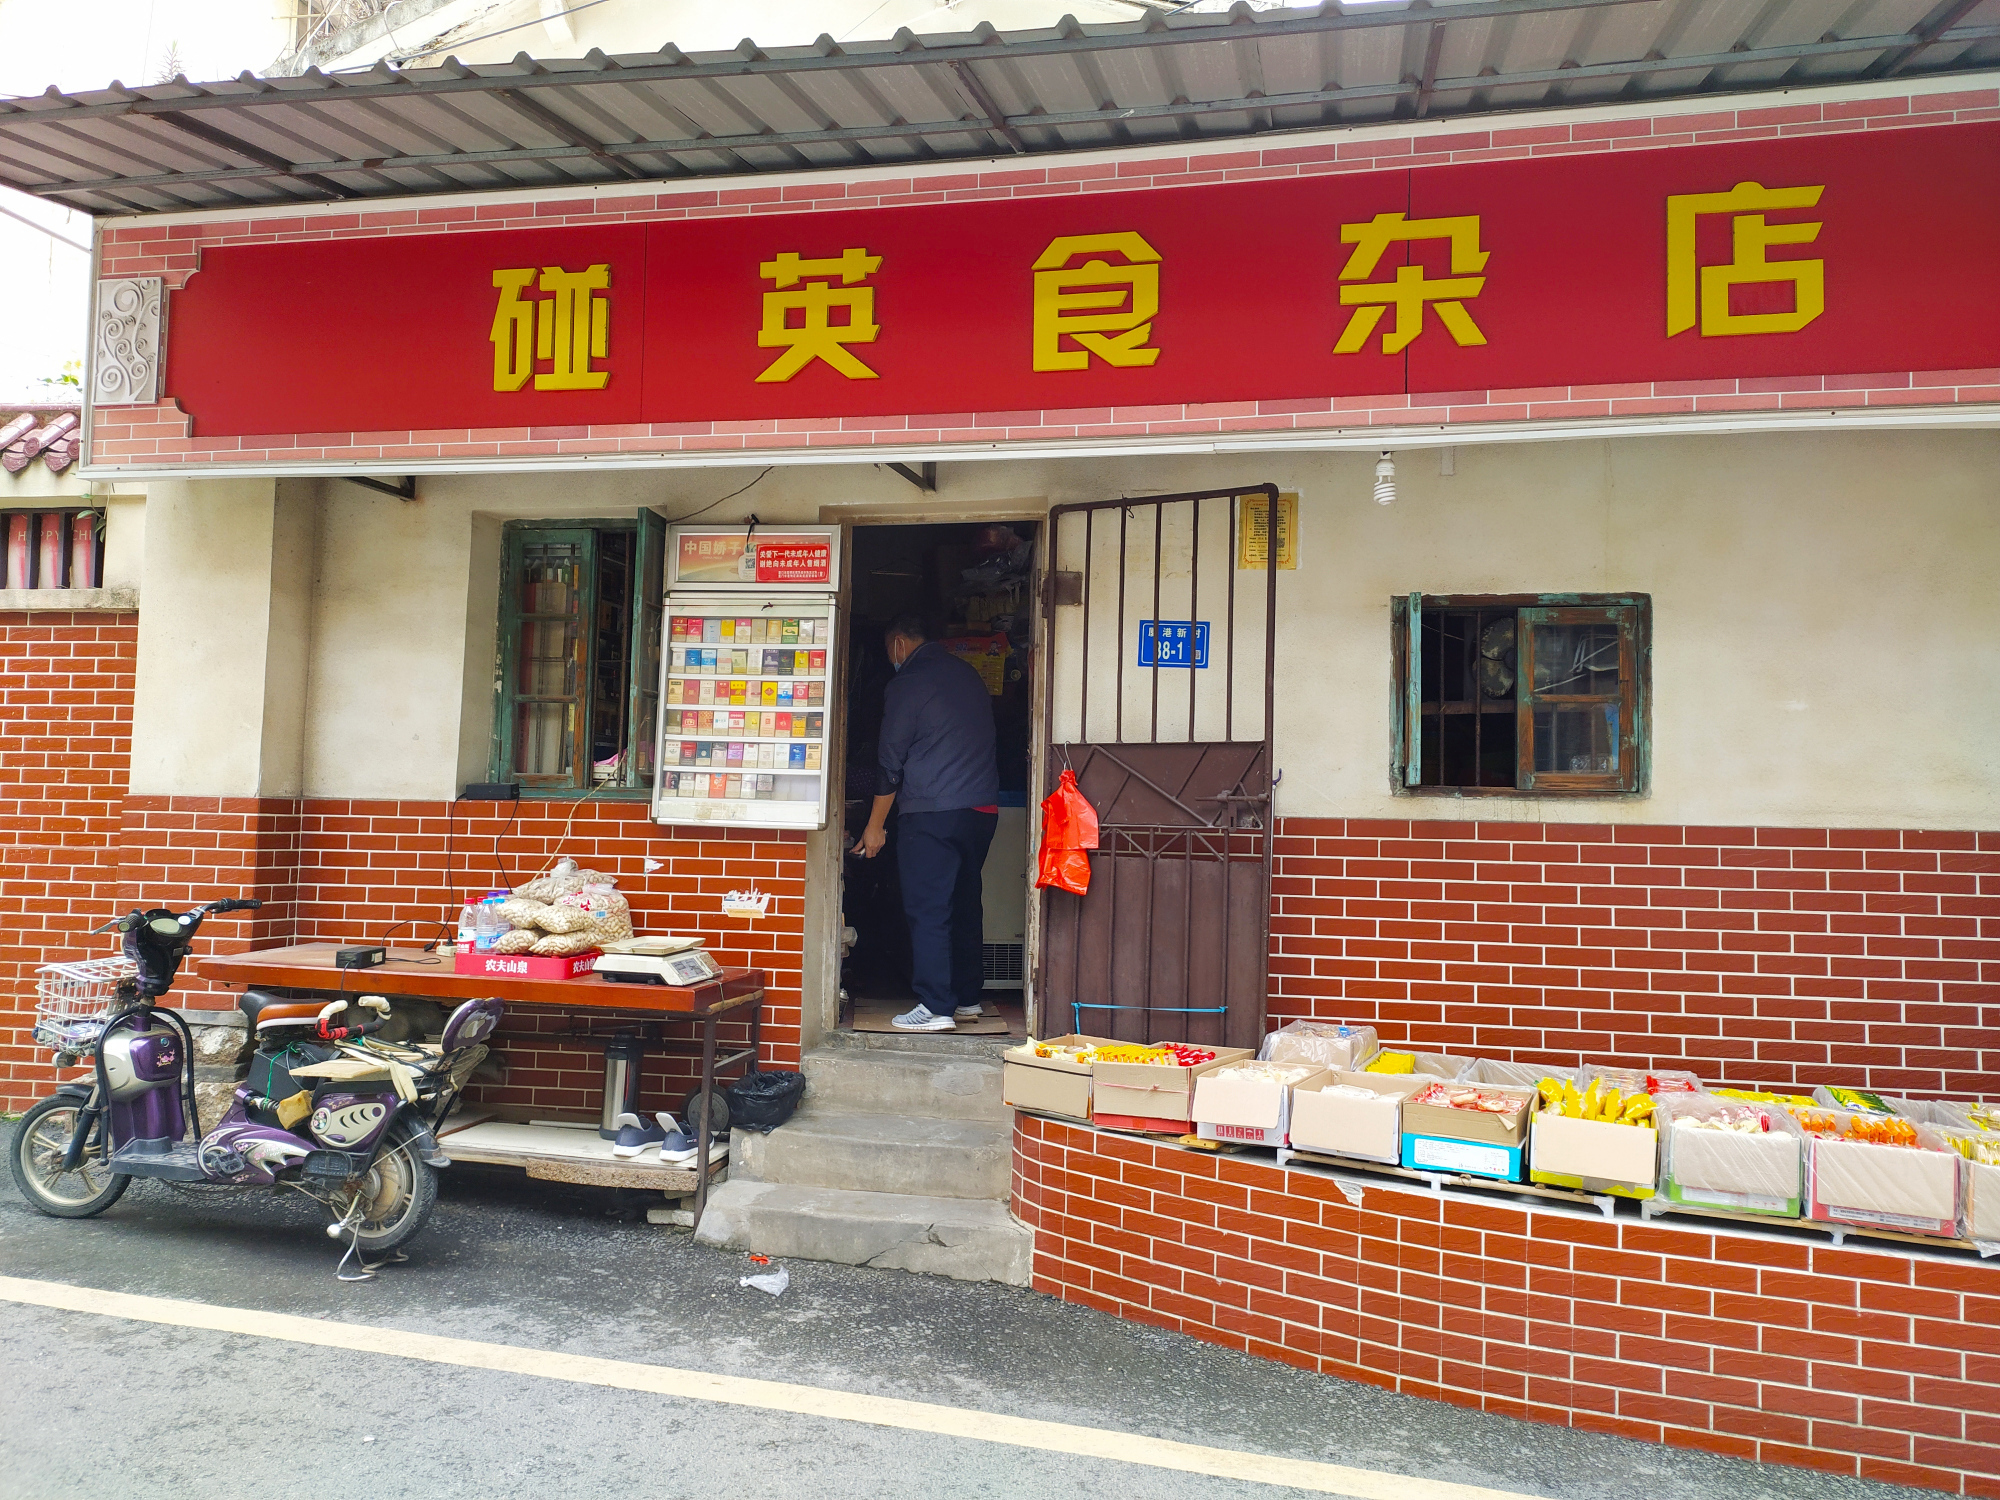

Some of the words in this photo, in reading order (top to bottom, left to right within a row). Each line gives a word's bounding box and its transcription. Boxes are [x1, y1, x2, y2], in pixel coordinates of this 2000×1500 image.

[490, 181, 1826, 393] 碰英食杂店
[684, 540, 742, 556] 中国娇子
[759, 549, 827, 558] 关爱下一代未成年人健康
[485, 958, 528, 974] 农夫山泉
[572, 957, 596, 974] 农夫山泉
